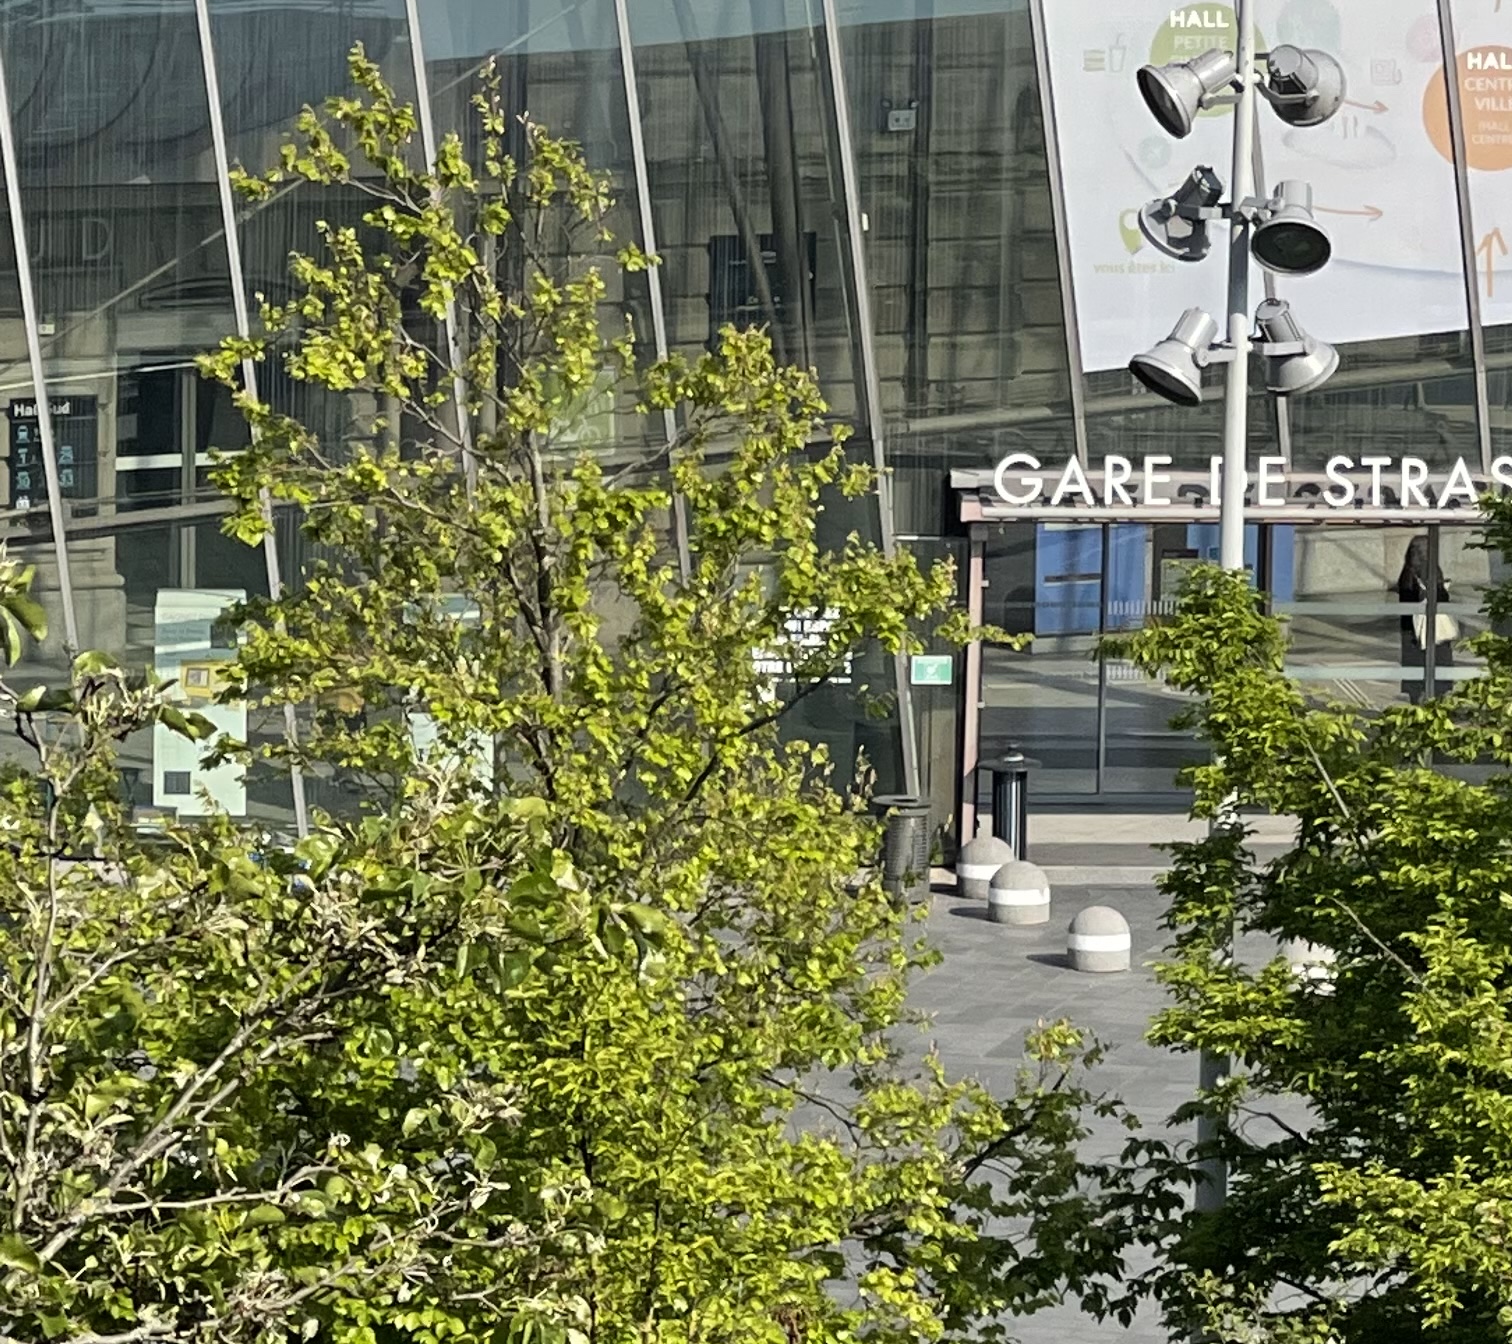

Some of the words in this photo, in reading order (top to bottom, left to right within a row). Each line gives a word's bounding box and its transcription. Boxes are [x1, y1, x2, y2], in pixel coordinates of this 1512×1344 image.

[1169, 9, 1230, 28] HALL
[1173, 35, 1229, 50] PETITE
[993, 453, 1173, 507] GARE
